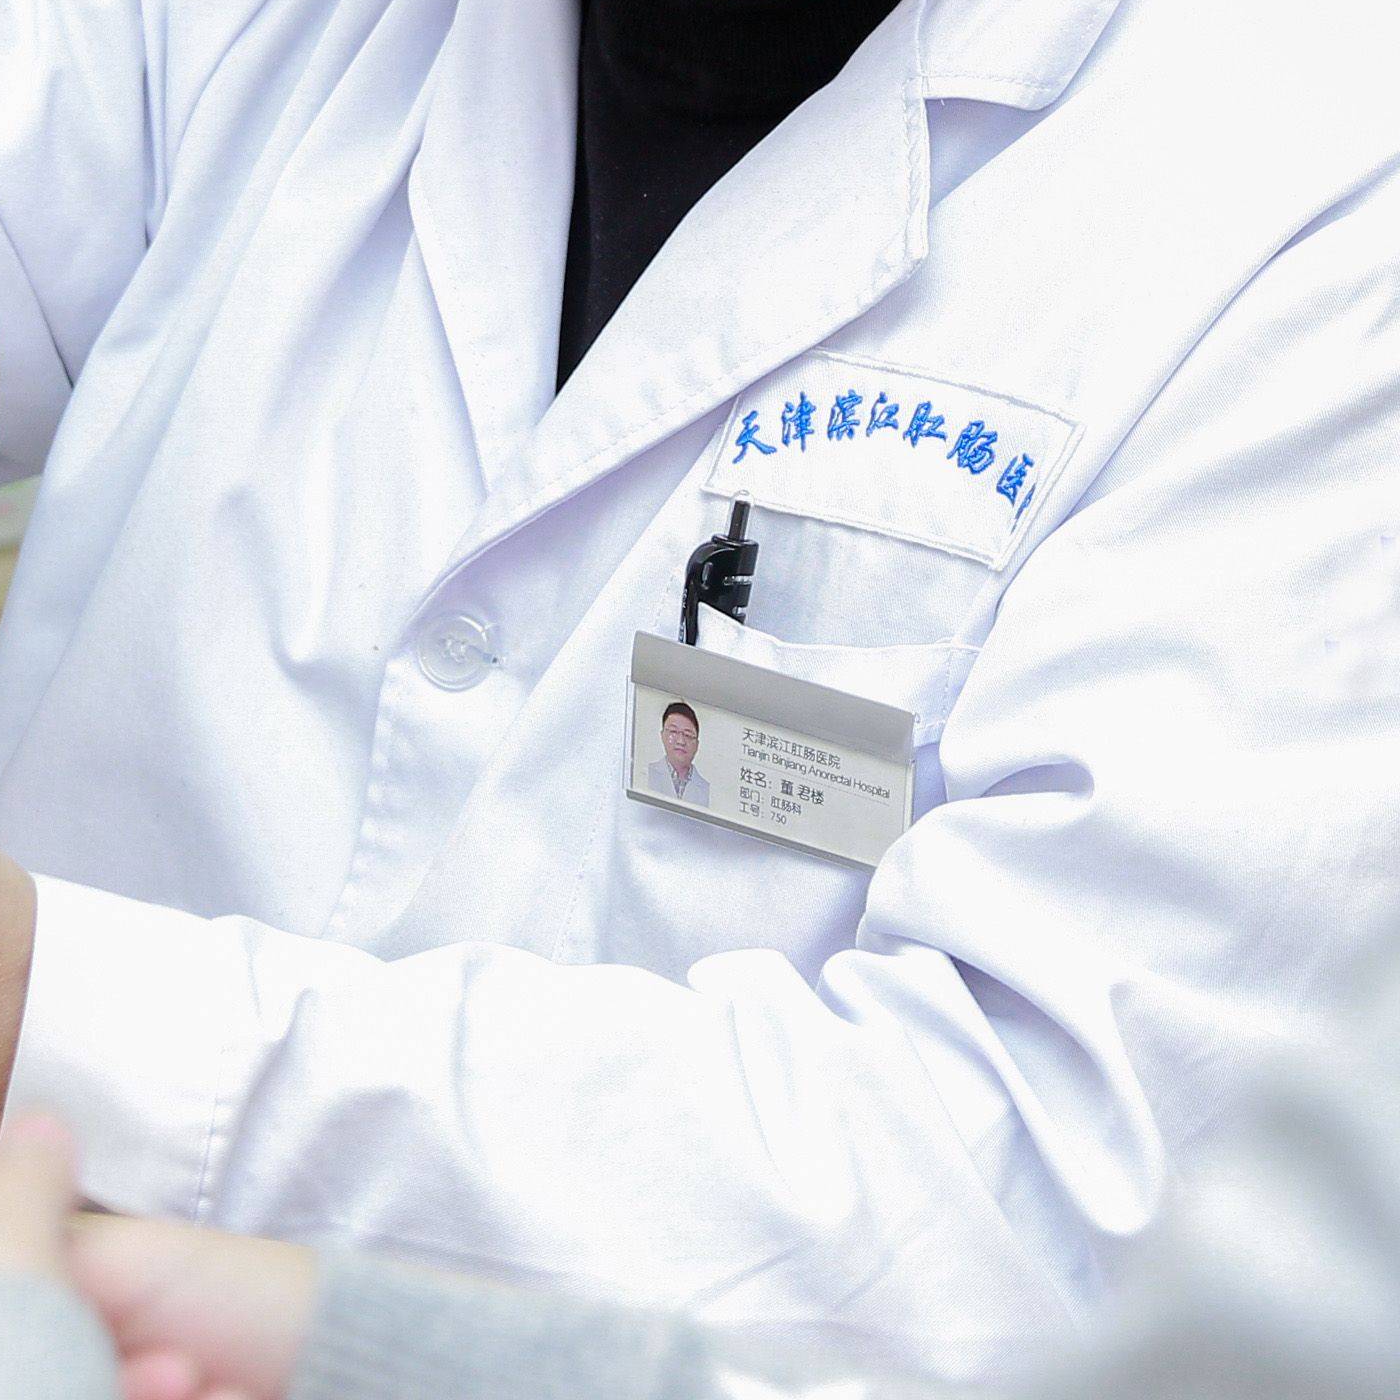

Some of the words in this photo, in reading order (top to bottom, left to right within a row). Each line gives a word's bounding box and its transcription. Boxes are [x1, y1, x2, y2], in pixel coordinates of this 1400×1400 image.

[742, 727, 841, 770] 天津滨江肛肠医院
[742, 744, 770, 762] Tianjin
[772, 754, 807, 776] Binjiang
[808, 767, 852, 787] Anorectal
[853, 778, 890, 799] Hospital
